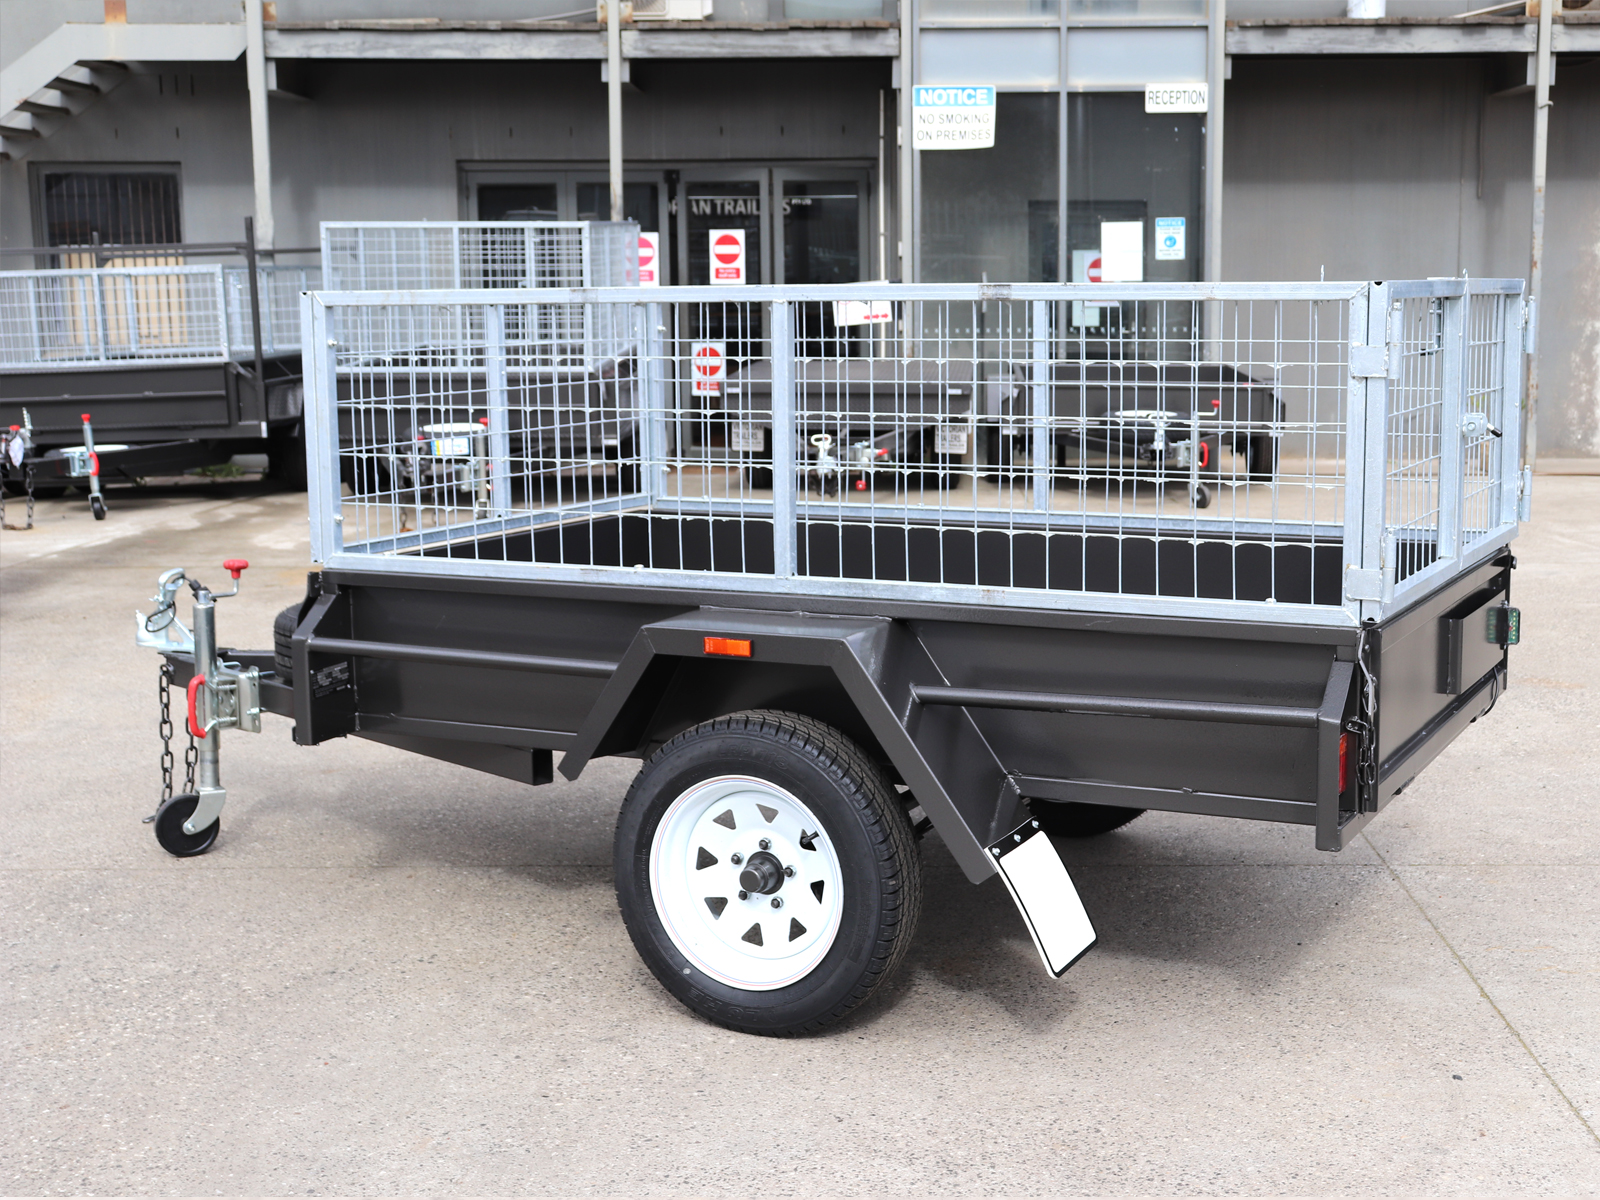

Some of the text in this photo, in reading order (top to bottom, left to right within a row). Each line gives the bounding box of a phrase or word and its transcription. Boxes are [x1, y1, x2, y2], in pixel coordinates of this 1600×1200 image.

[919, 88, 988, 105] NOTICE
[1147, 89, 1206, 105] RECEPTION
[918, 112, 990, 125] NO SMOKING
[916, 128, 991, 141] ON PREMISES
[714, 199, 791, 215] TRAILS
